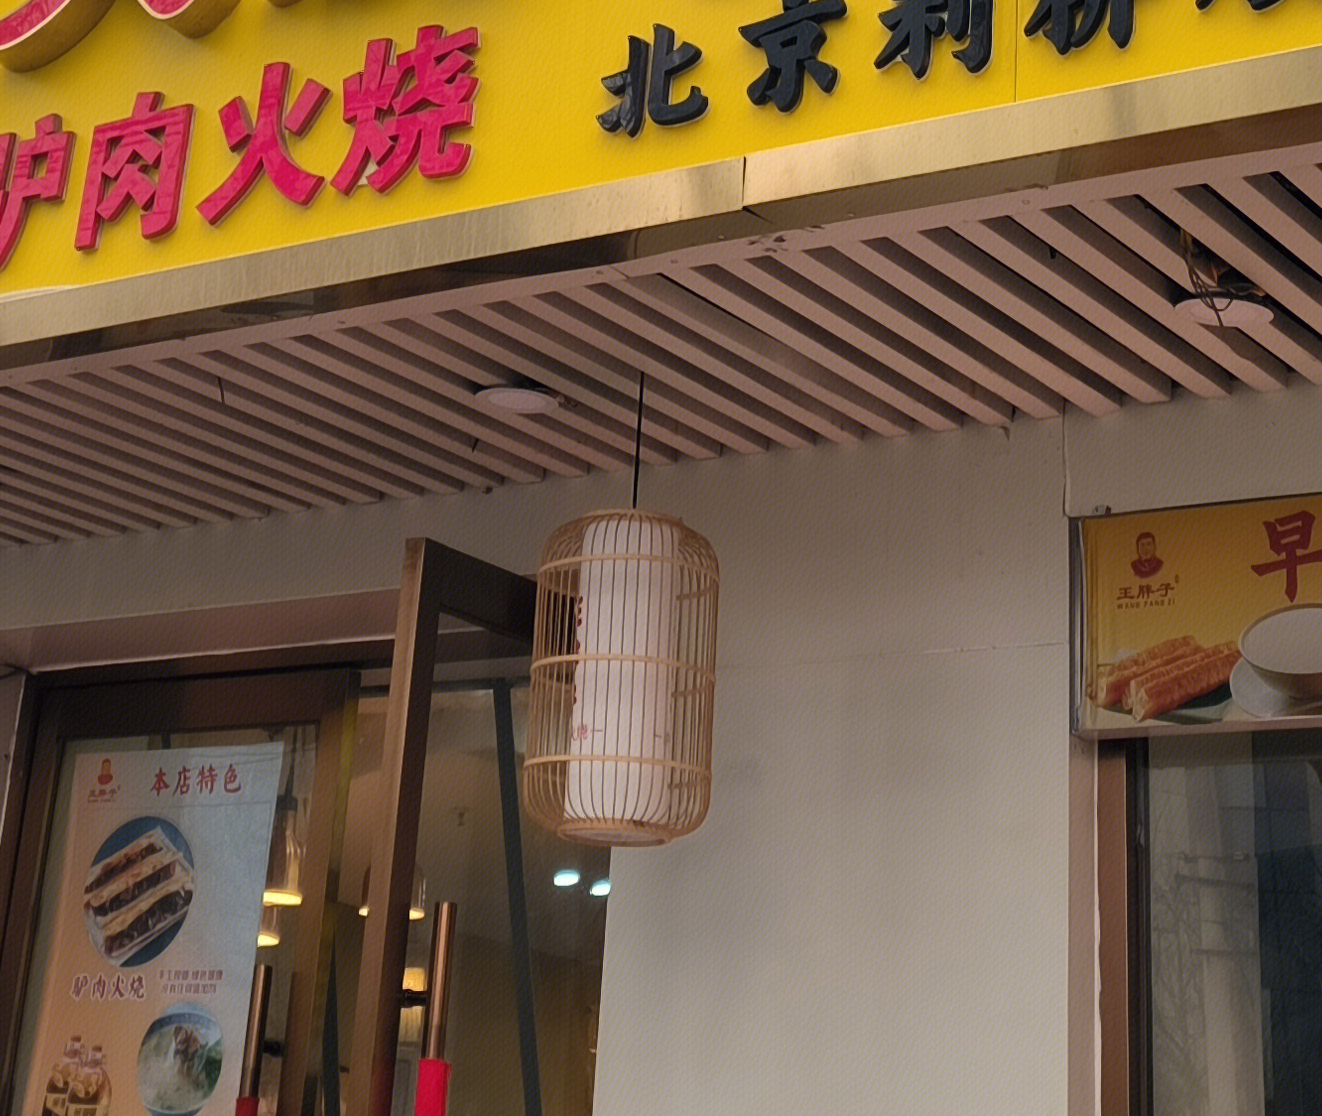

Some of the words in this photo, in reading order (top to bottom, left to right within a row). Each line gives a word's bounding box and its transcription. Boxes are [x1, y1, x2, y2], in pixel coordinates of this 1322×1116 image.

[1116, 582, 1175, 601] 王胖子
[150, 763, 243, 798] 本店特色
[70, 972, 147, 1000] 驴肉火烧
